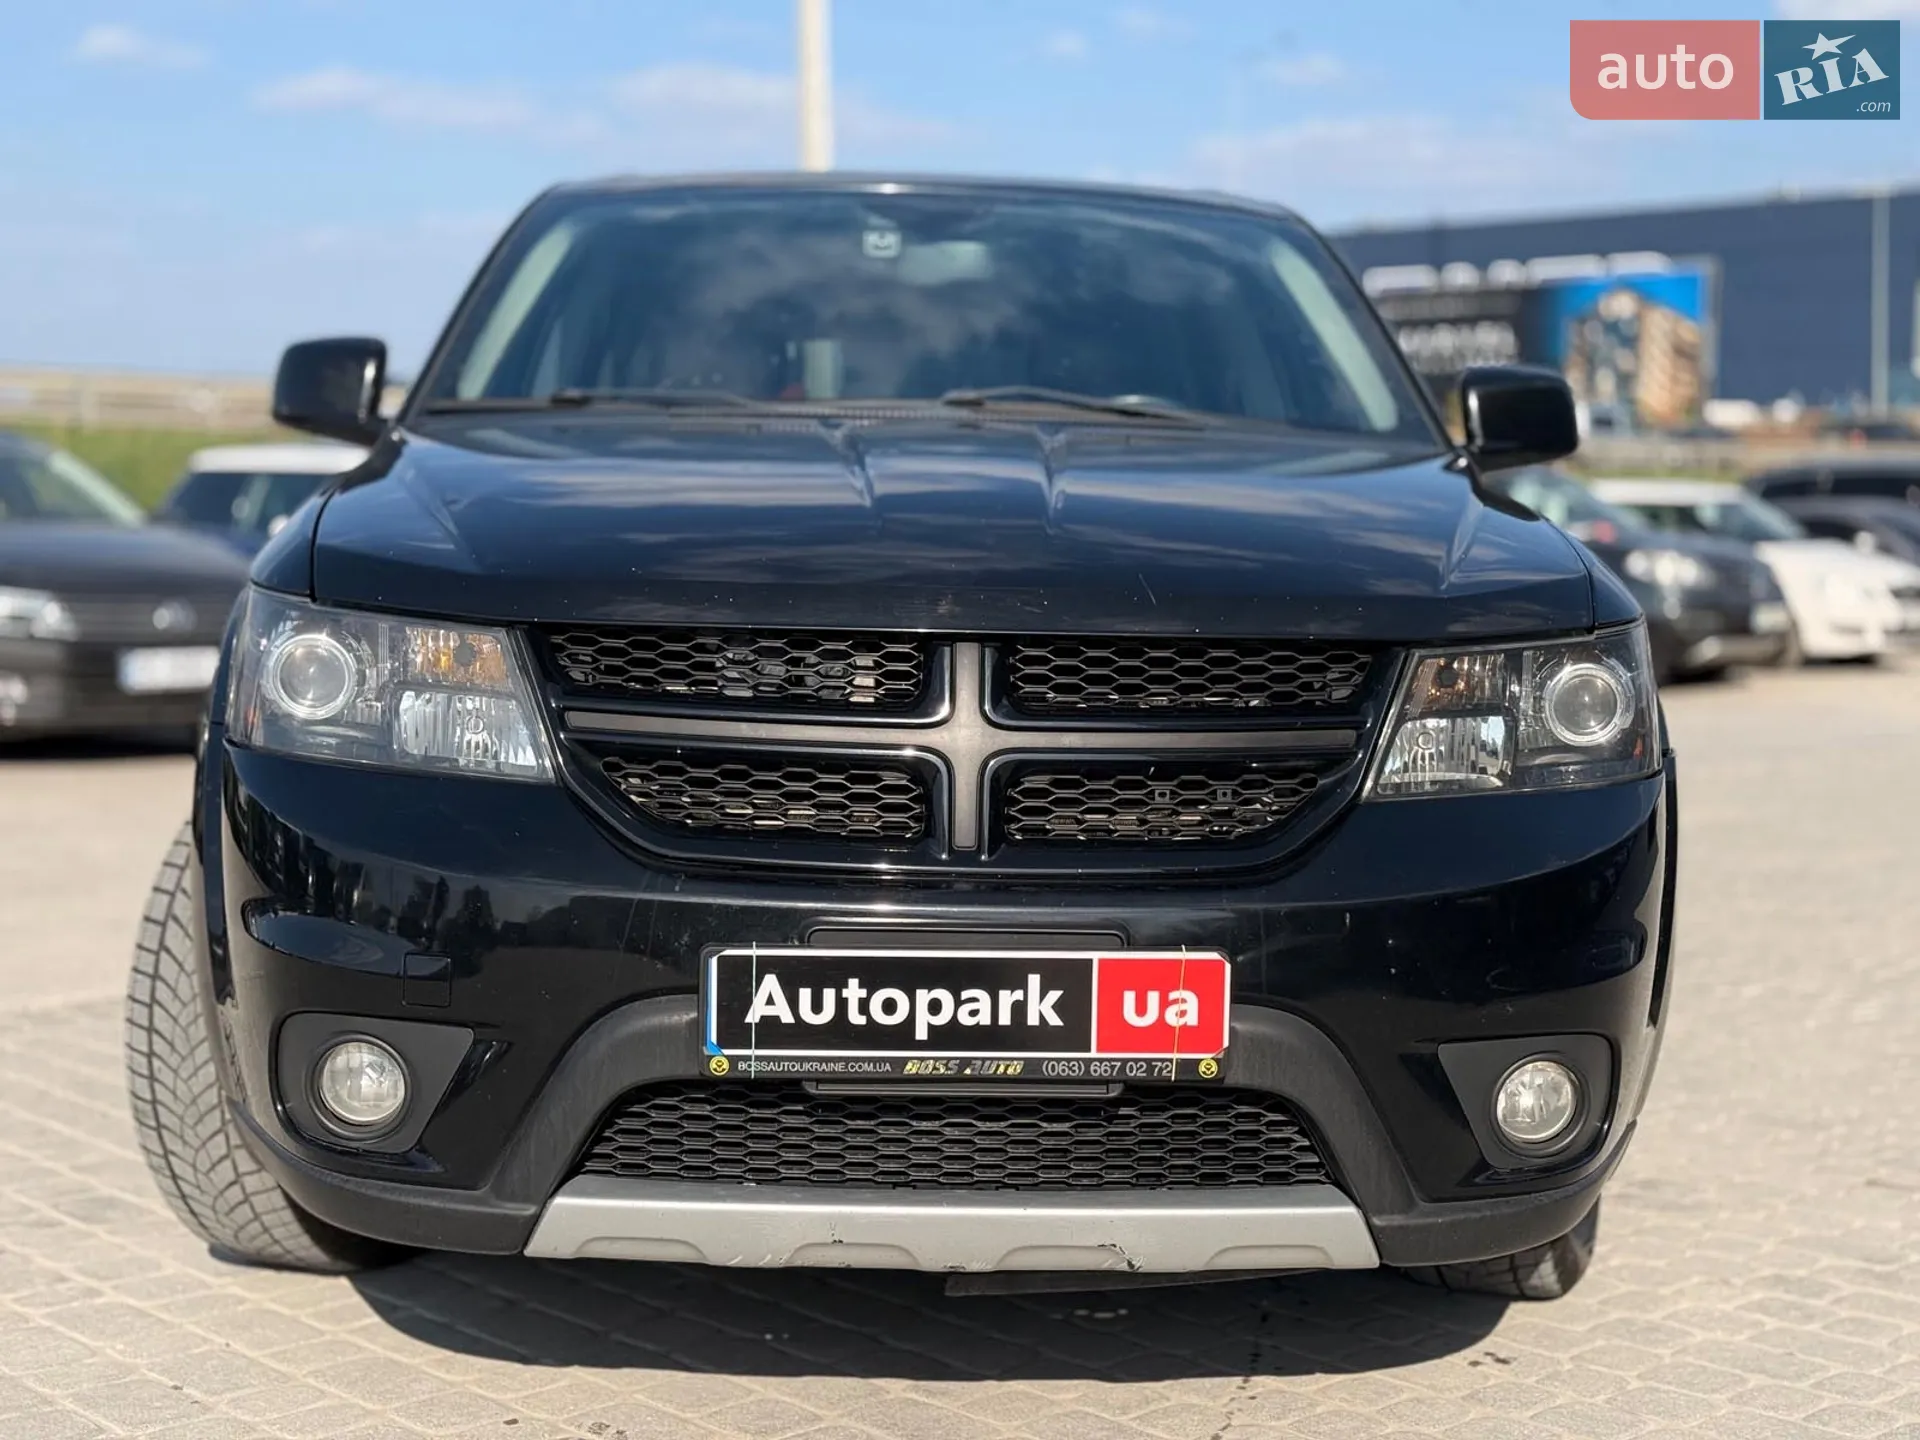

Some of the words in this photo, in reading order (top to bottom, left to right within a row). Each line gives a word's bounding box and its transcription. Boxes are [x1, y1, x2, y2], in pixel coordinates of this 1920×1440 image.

[744, 973, 1064, 1041] Autopark
[1120, 988, 1199, 1028] ua
[737, 1060, 892, 1073] BOSSAUTOUKRAINE.COM.UA
[903, 1059, 960, 1075] BOSS
[963, 1060, 1025, 1075] AUTO
[1042, 1060, 1085, 1077] (063)
[1090, 1061, 1120, 1077] 667
[1126, 1061, 1147, 1077] 02
[1152, 1061, 1173, 1077] 72
